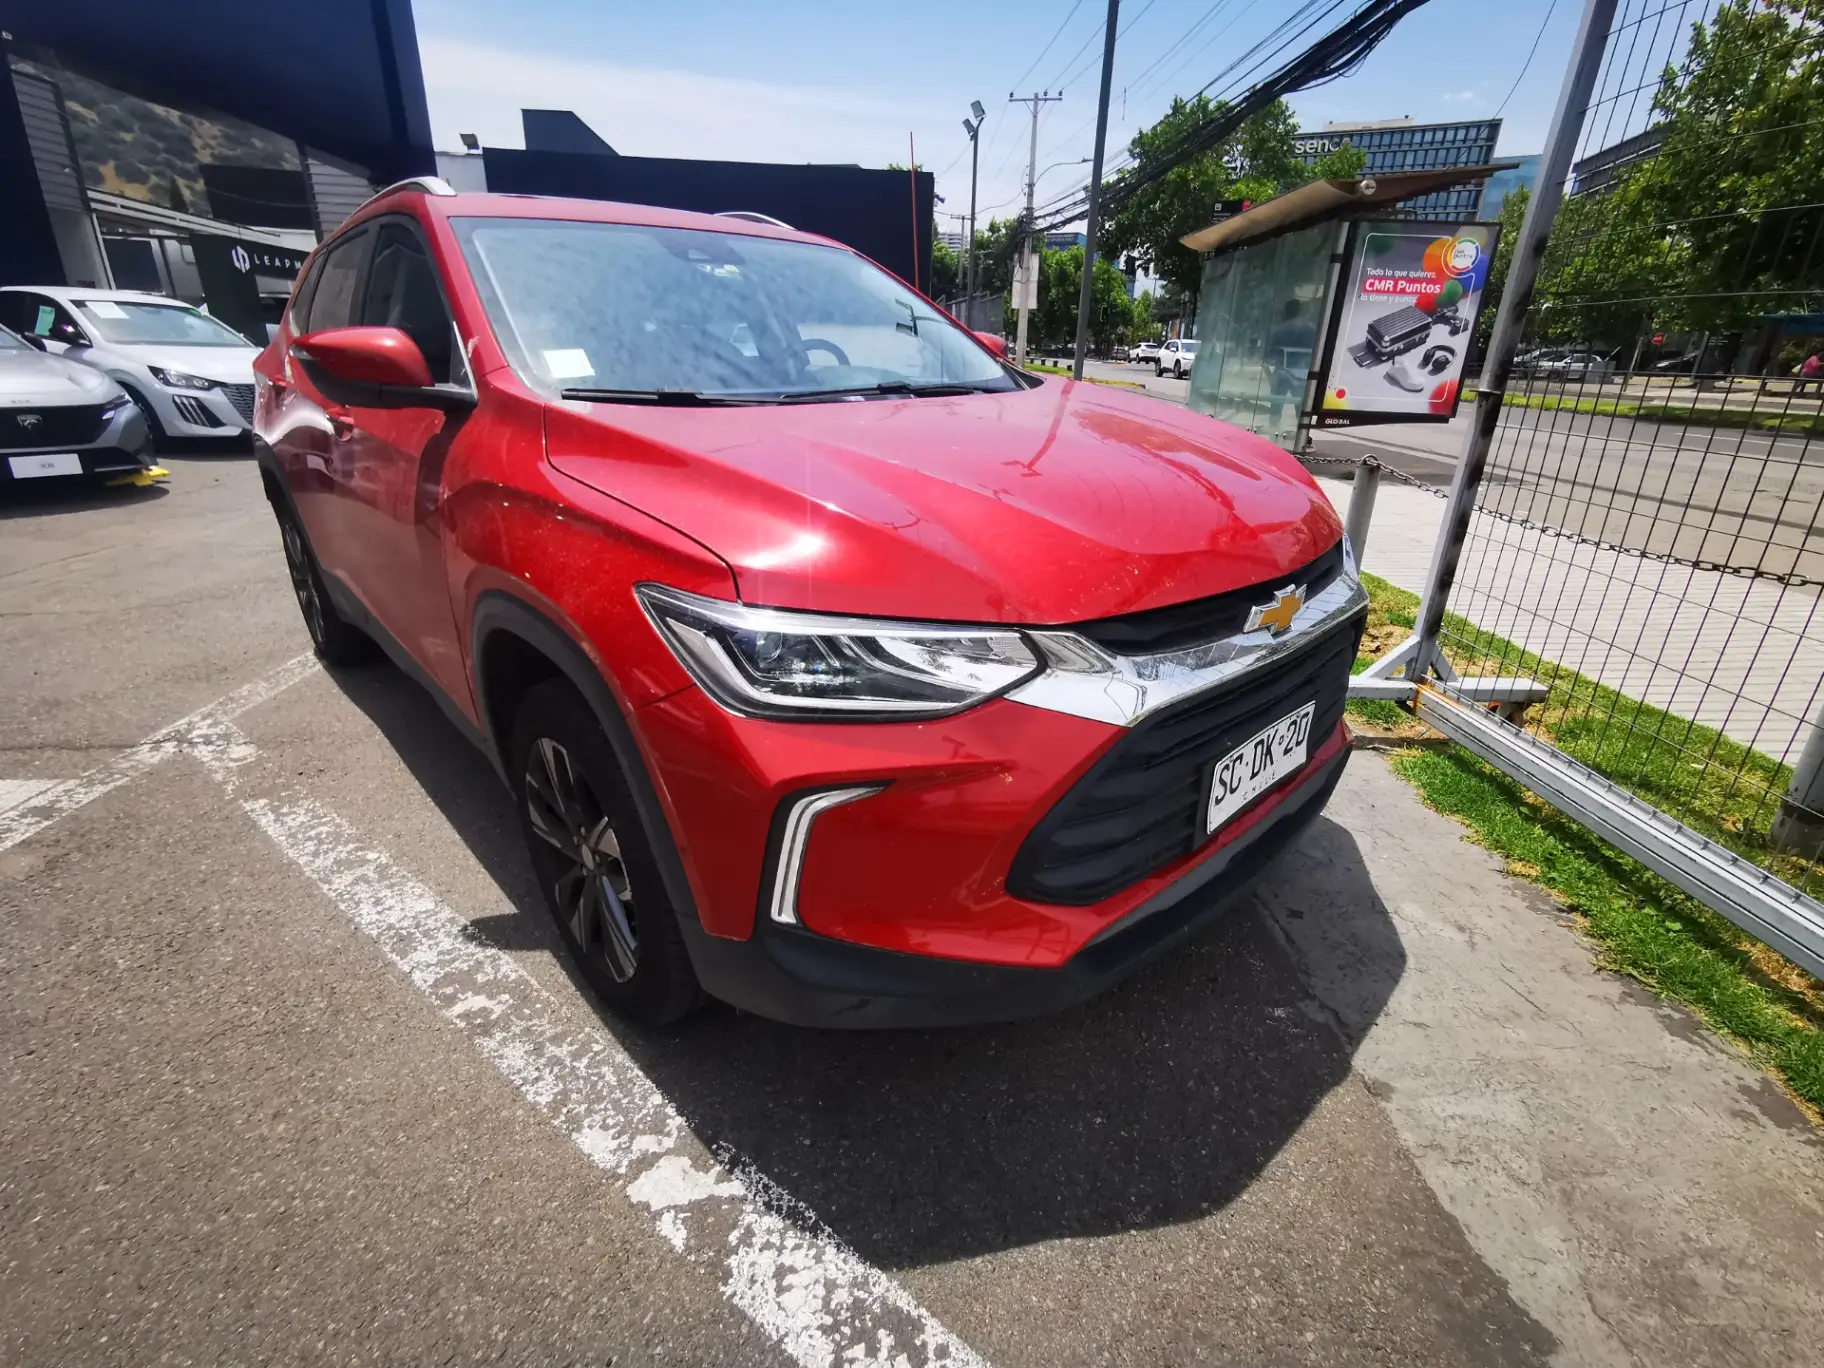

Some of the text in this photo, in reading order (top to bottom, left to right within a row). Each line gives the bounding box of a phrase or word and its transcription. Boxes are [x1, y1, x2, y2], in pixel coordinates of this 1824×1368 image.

[1291, 138, 1351, 154] senc
[1367, 267, 1384, 276] Todo
[1385, 268, 1393, 276] lo
[1394, 270, 1407, 278] que
[1365, 279, 1441, 293] CMR Puntos
[1369, 293, 1387, 301] tiene
